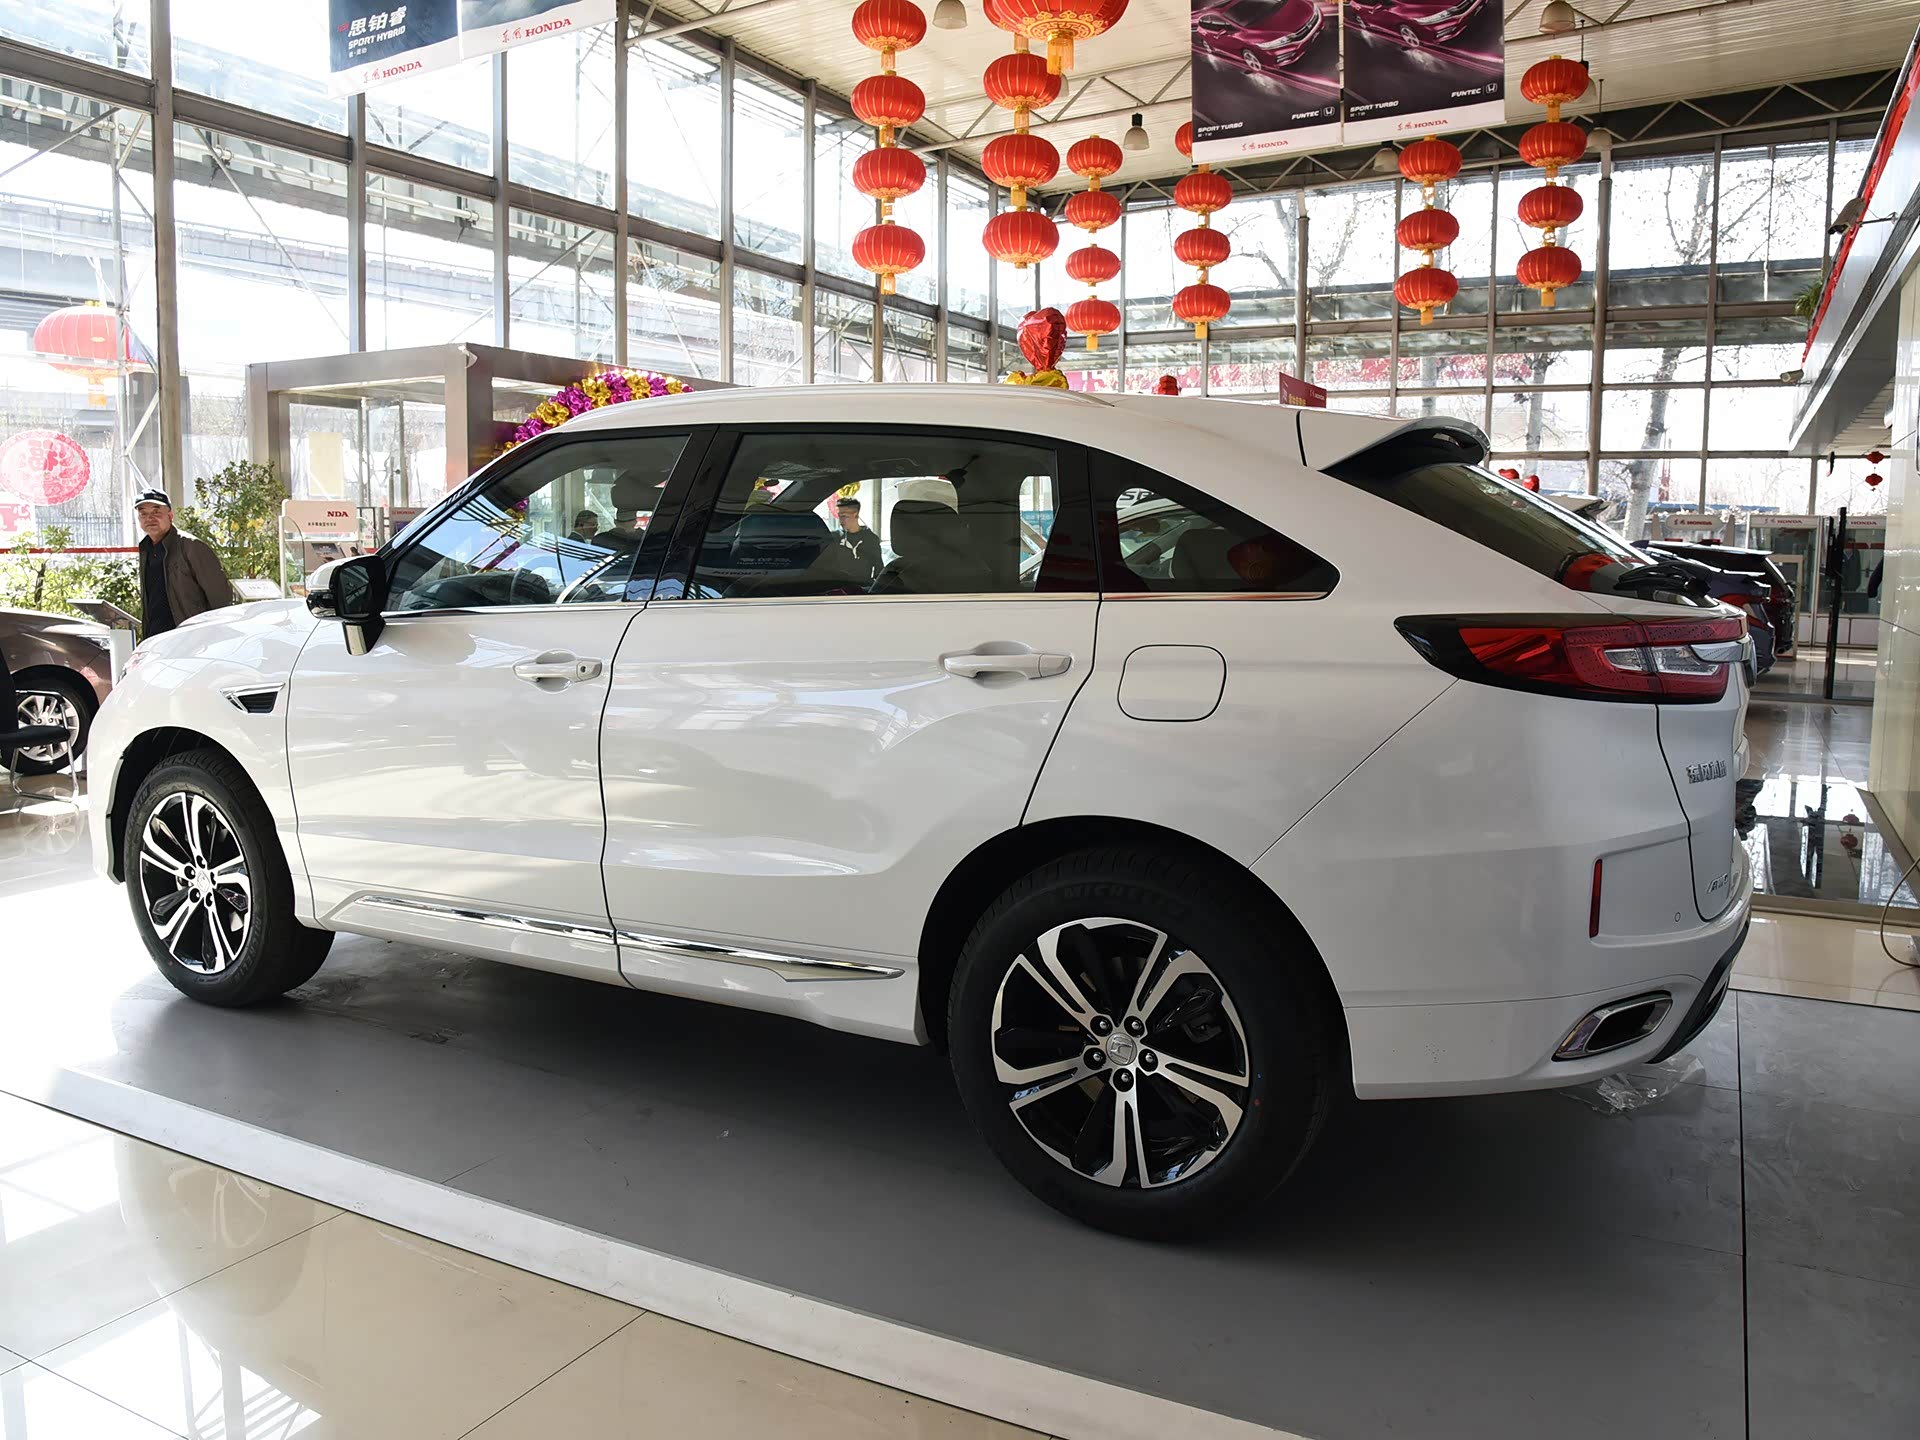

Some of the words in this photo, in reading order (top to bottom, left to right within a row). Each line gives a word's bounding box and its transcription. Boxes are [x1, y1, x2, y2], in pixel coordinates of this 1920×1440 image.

[348, 5, 407, 37] 思铂睿
[525, 18, 572, 37] HONDA
[348, 35, 376, 50] SPORT
[376, 25, 406, 42] HYBRID
[382, 61, 423, 78] HONDA
[1451, 87, 1482, 98] FUNTEC
[1350, 103, 1373, 113] SPORT
[1374, 100, 1399, 109] TURBO
[1291, 110, 1320, 120] FUNTEC
[1197, 124, 1220, 133] SPORT
[1220, 121, 1244, 131] TURBO
[1414, 119, 1449, 129] HONDA
[1257, 140, 1289, 149] HONDA
[327, 510, 349, 518] NDA
